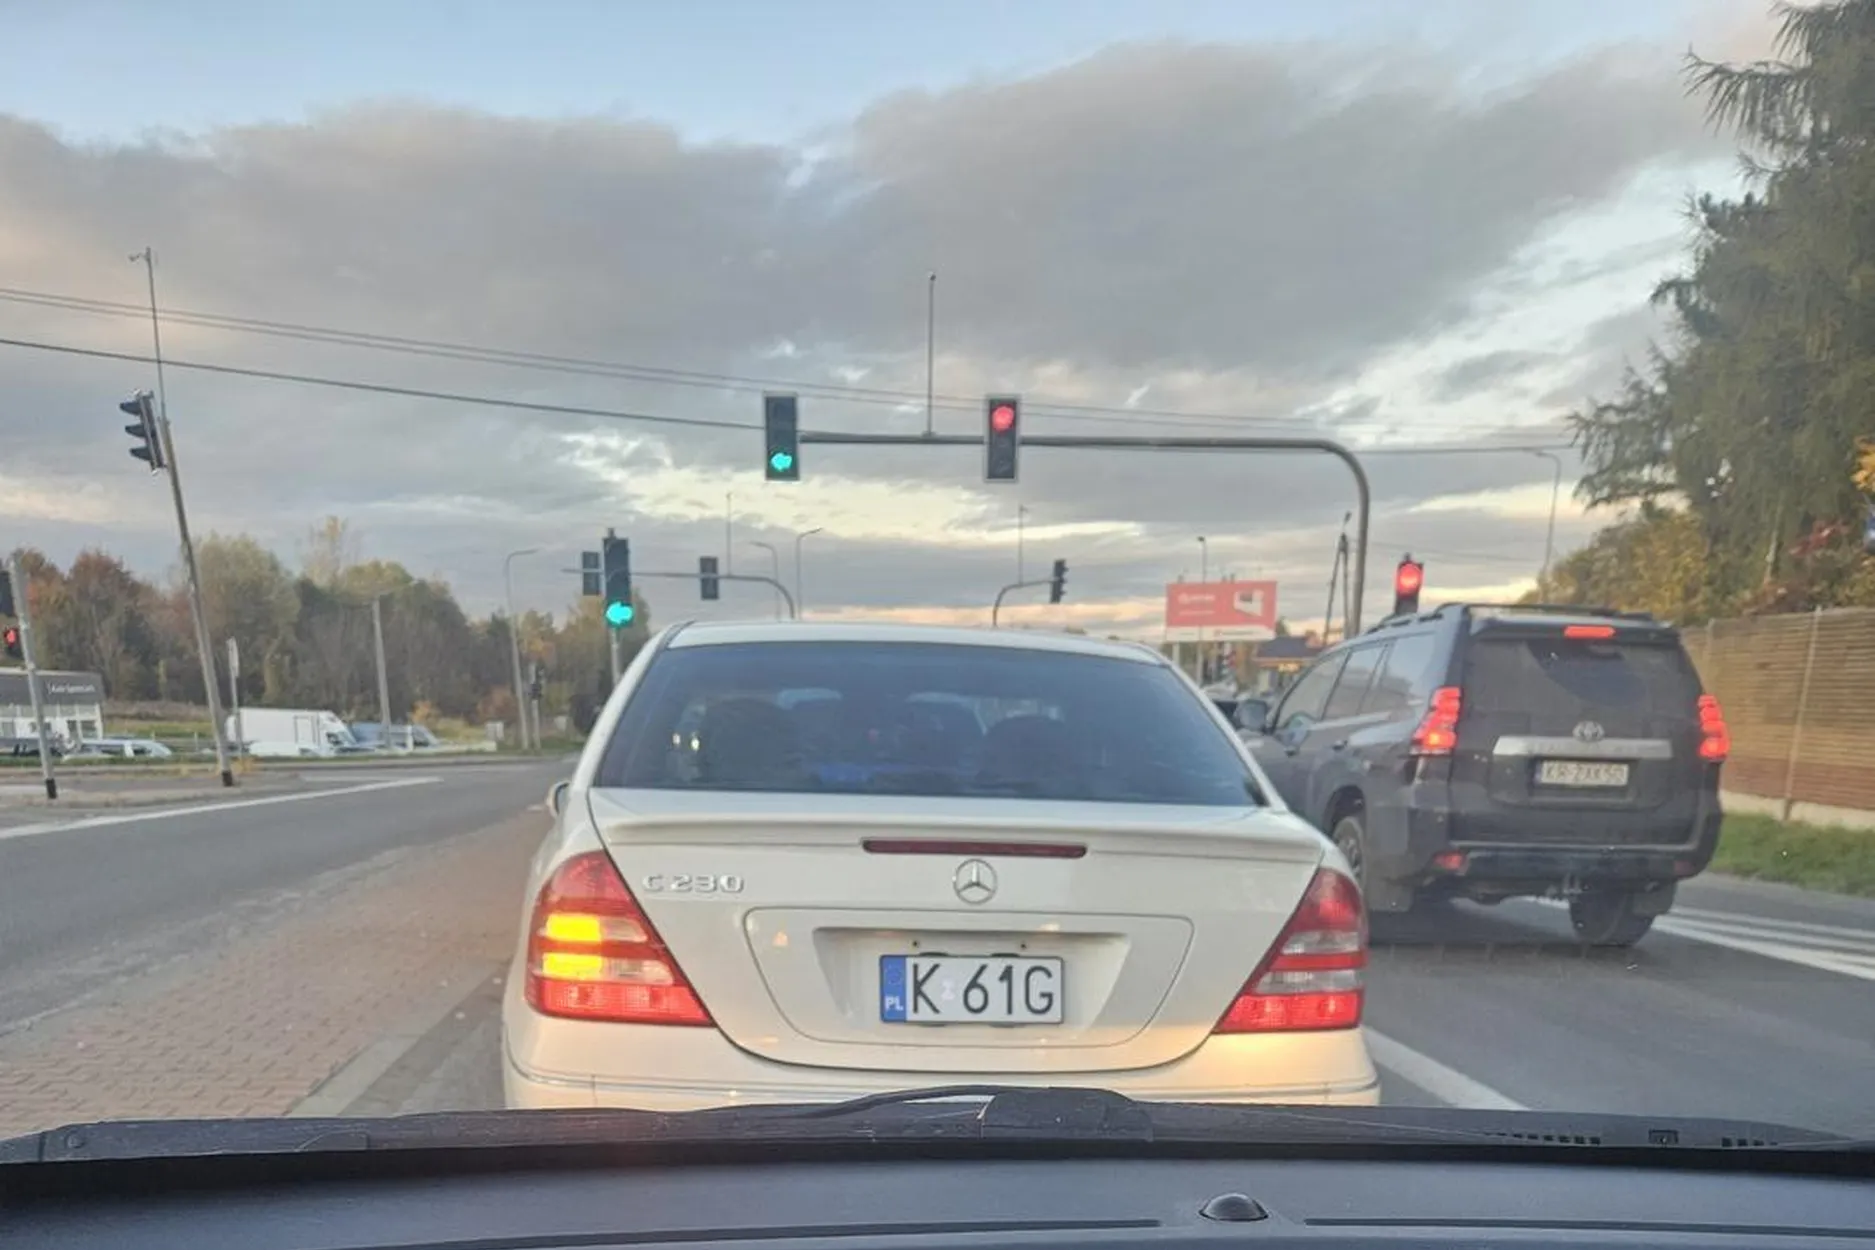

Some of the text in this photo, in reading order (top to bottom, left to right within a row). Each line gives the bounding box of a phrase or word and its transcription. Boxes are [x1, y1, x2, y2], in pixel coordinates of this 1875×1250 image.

[642, 874, 745, 893] C 230
[912, 963, 1054, 1016] K 61G
[884, 995, 904, 1011] PL
